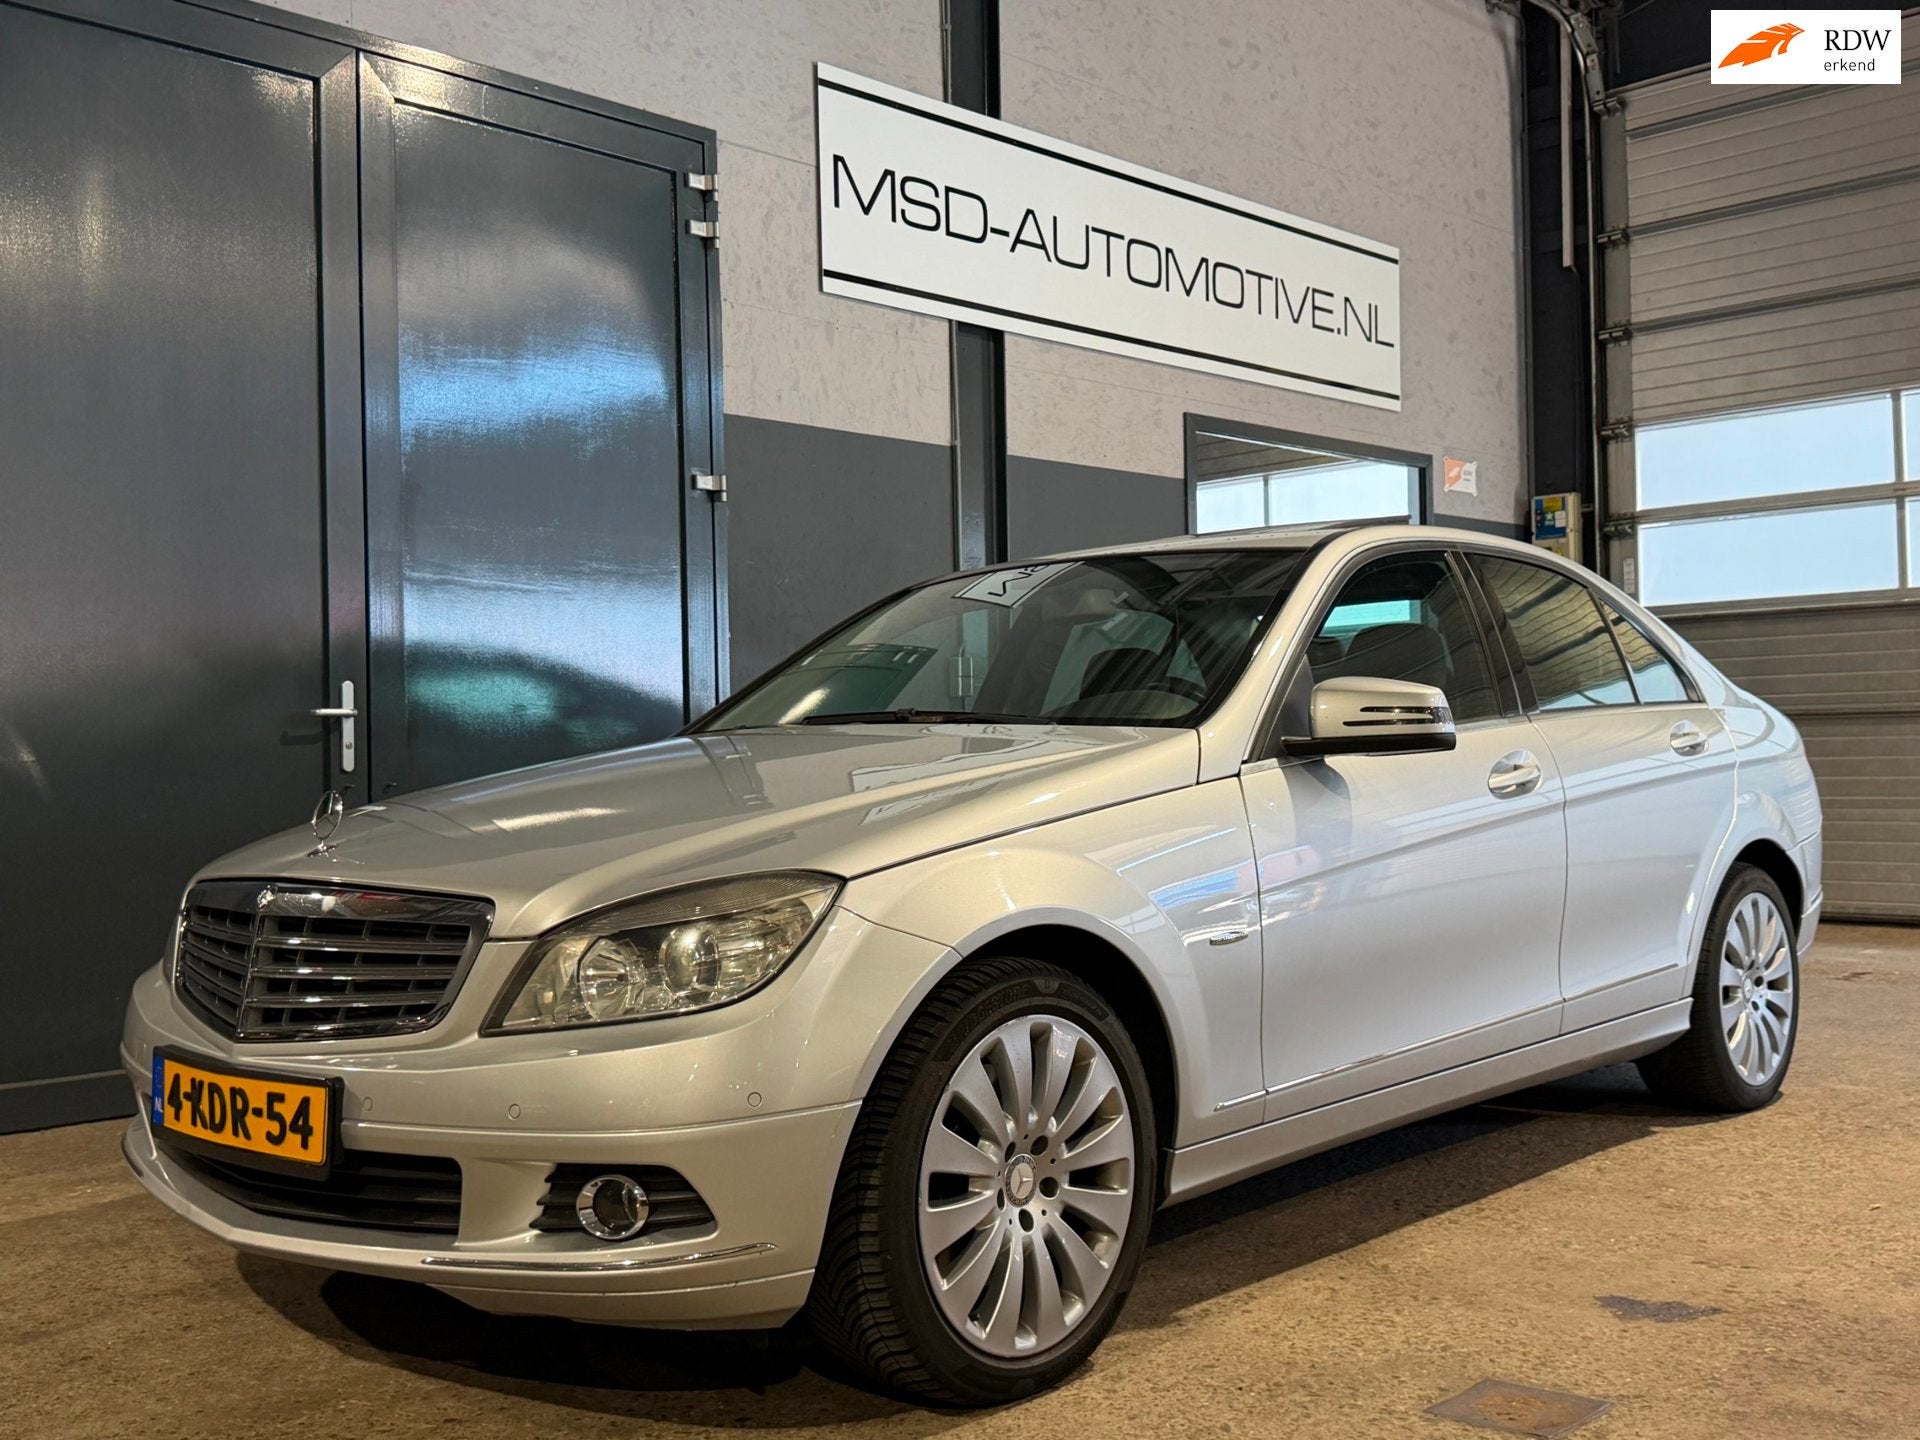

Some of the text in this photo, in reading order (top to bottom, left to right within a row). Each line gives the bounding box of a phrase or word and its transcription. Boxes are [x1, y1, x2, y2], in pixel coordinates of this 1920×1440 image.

[832, 153, 1395, 348] MSD-AUTOMOTIVE.NL
[154, 1096, 164, 1113] NL
[167, 1073, 314, 1150] 4-KDR-54
